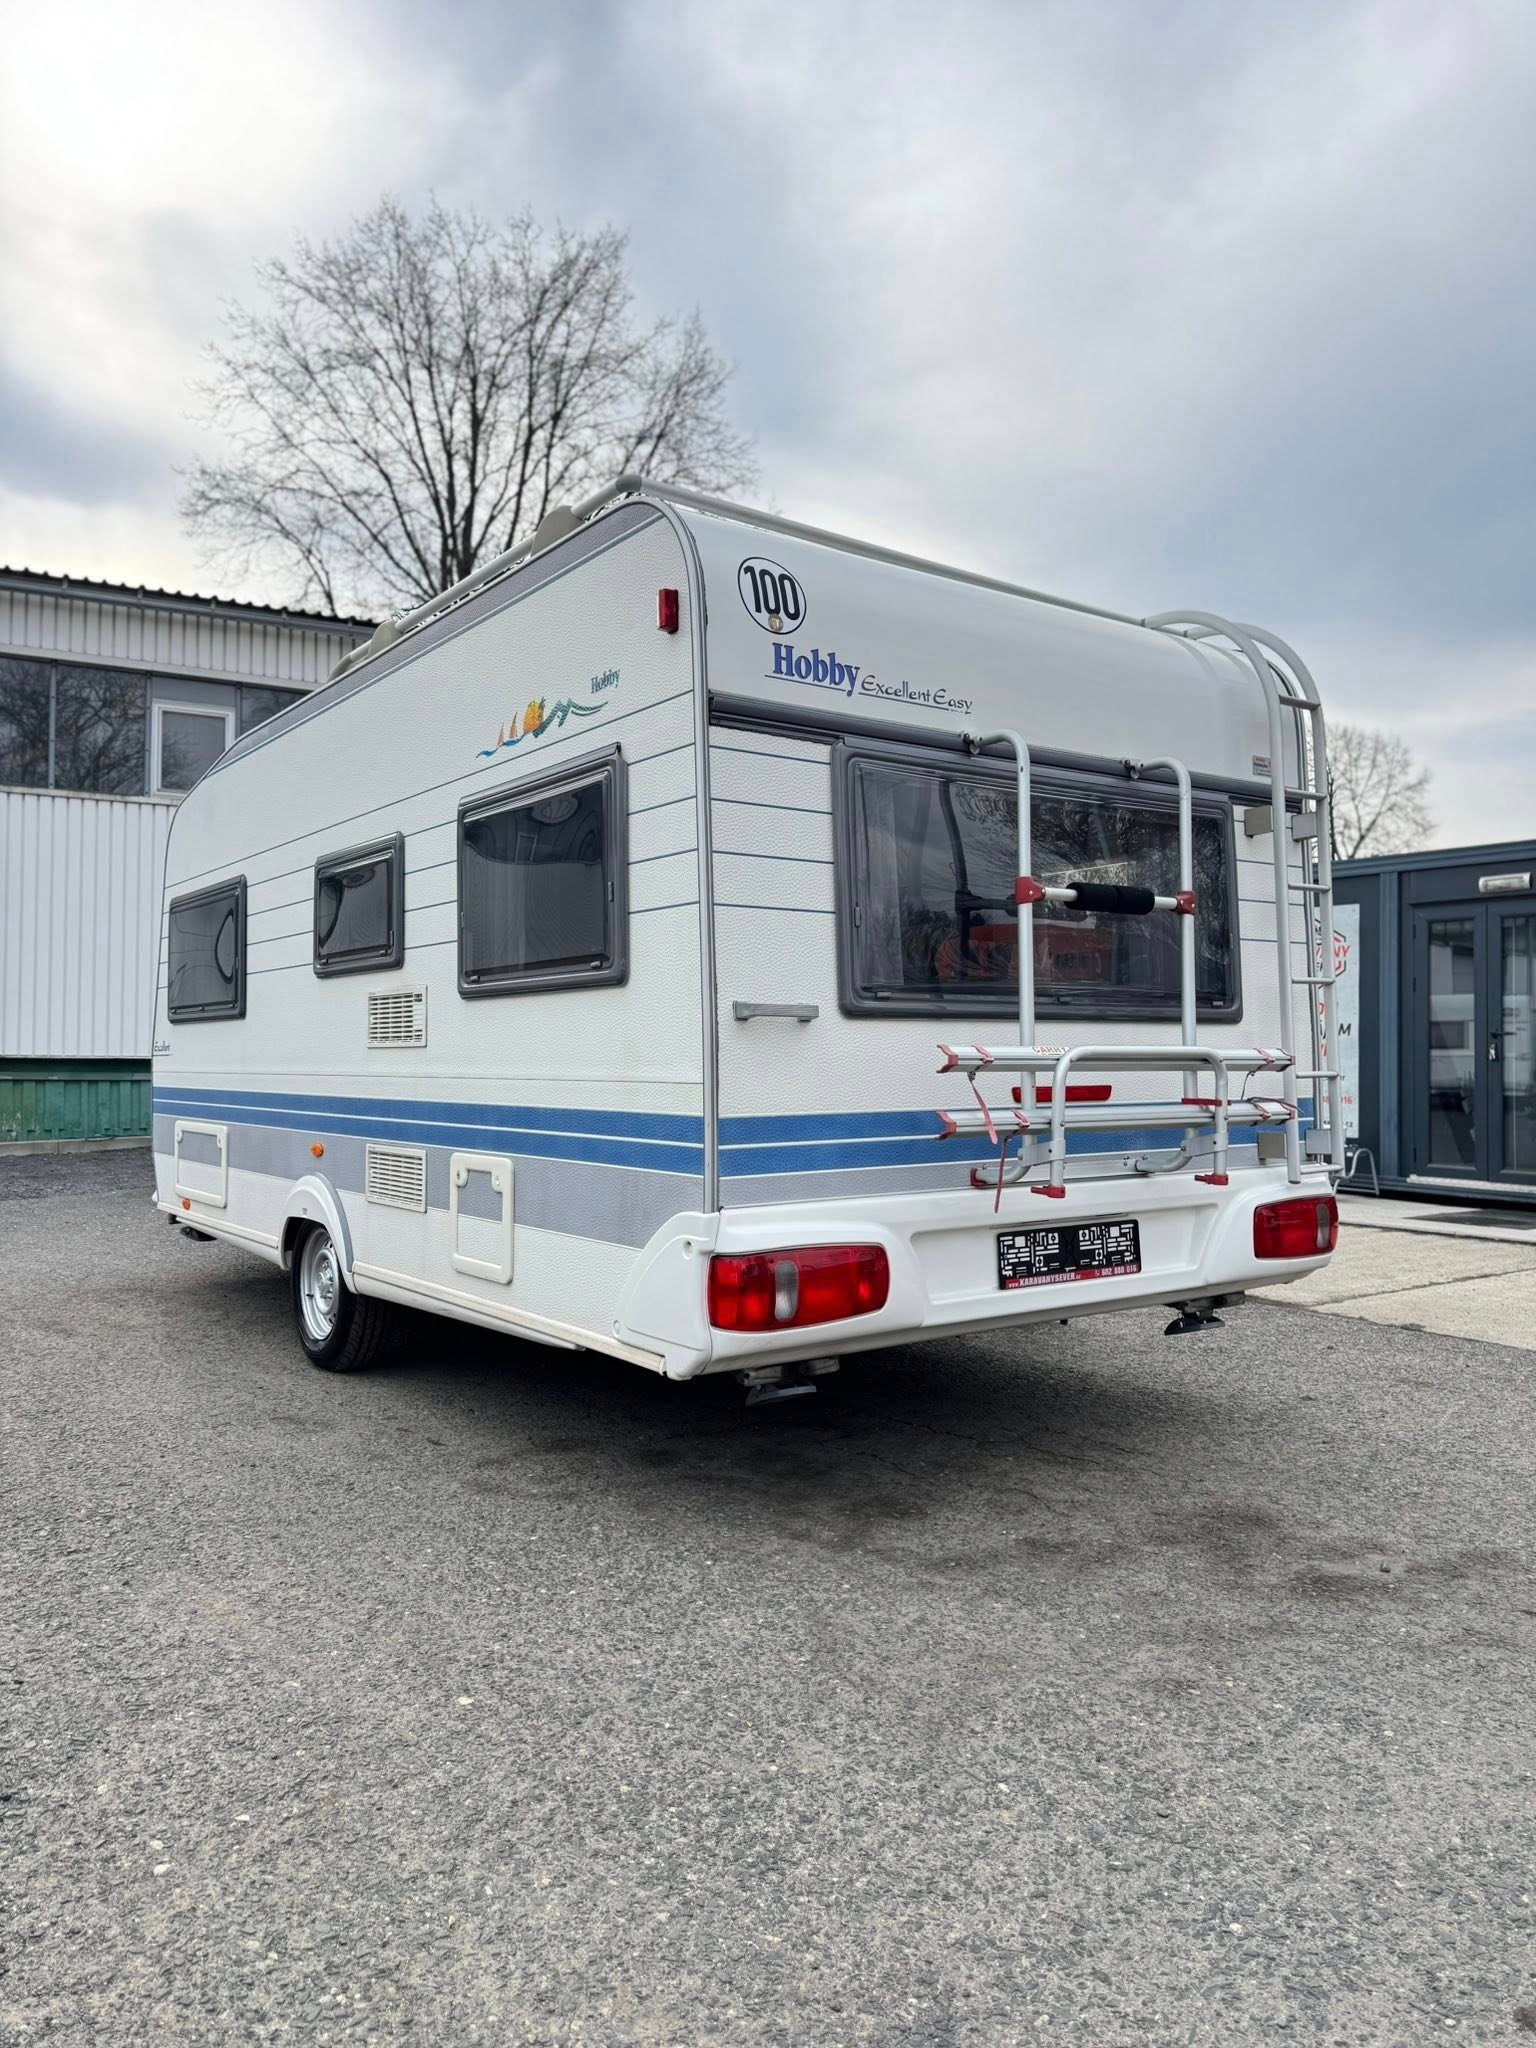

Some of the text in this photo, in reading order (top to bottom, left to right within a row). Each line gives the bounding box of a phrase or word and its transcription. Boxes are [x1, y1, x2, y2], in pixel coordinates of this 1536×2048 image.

[743, 565, 801, 621] 100
[590, 669, 620, 694] Hobby
[771, 642, 973, 714] Hobby Excellent Easy
